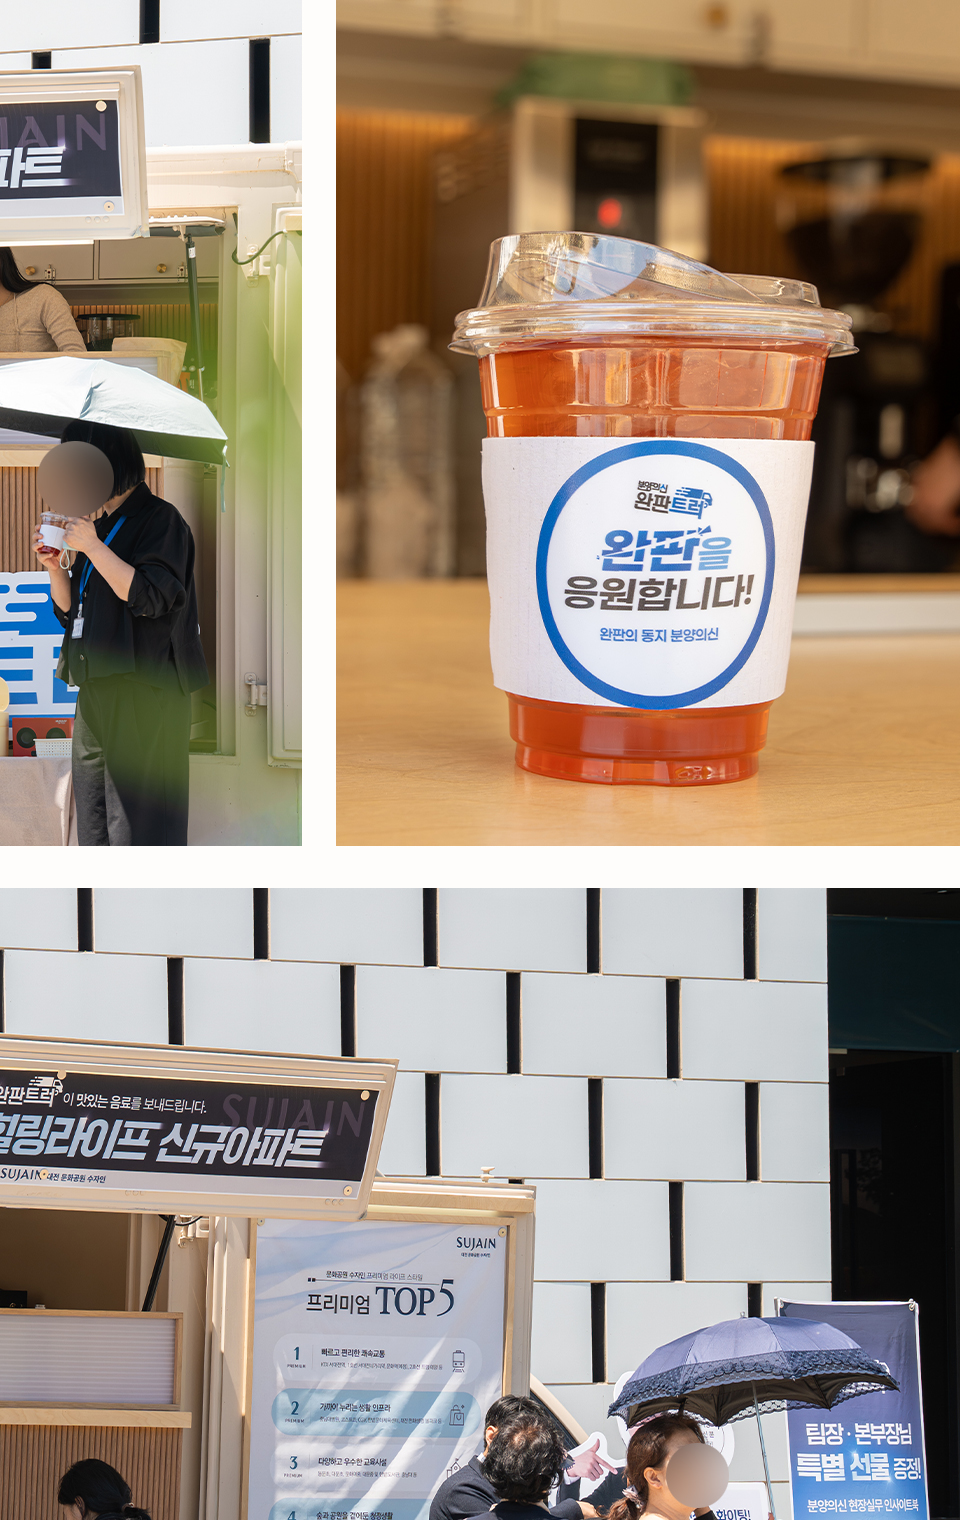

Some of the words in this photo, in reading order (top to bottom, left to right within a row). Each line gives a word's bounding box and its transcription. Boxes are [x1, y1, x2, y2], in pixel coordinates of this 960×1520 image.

[637, 480, 669, 494] 분양의신
[634, 490, 705, 520] 완판트럭
[600, 528, 732, 572] 완판을
[563, 573, 755, 611] 응원합니다!
[599, 627, 638, 643] 완판의
[641, 627, 667, 643] 동지
[670, 627, 719, 643] 분양의신
[63, 1092, 74, 1106] 이
[76, 1093, 108, 1109] 맛있는
[110, 1095, 142, 1111] 음료를
[142, 1096, 207, 1114] 보내드립니다.
[220, 1093, 367, 1138] SUJAIN
[155, 1121, 330, 1168] 신규아파트
[0, 1167, 42, 1182] SUJAIN
[47, 1172, 60, 1183] 대전
[61, 1172, 86, 1184] 문화공원
[87, 1174, 106, 1184] 수자인
[456, 1236, 496, 1250] SUJAIN
[306, 1294, 370, 1315] 프리미엄
[293, 1346, 300, 1361] 1
[321, 1348, 340, 1357] 빠르고
[341, 1348, 361, 1358] 편리한
[361, 1349, 386, 1359] 쾌속교통
[290, 1400, 299, 1416] 2
[320, 1403, 339, 1412] 가까이
[340, 1403, 358, 1412] 누리는
[359, 1403, 371, 1412] 생활
[372, 1404, 391, 1412] 인프라
[805, 1422, 844, 1446] 팀장
[855, 1422, 912, 1446] 본부장님
[289, 1455, 298, 1470] 3
[318, 1457, 343, 1467] 다양하고
[344, 1458, 362, 1467] 우수한
[363, 1458, 387, 1467] 교육시설
[797, 1453, 846, 1482] 특별
[850, 1452, 891, 1482] 선물
[893, 1457, 922, 1481] 증정!
[807, 1499, 848, 1514] 분양의신
[848, 1499, 884, 1513] 현장실무
[883, 1498, 919, 1513] 인사이트북
